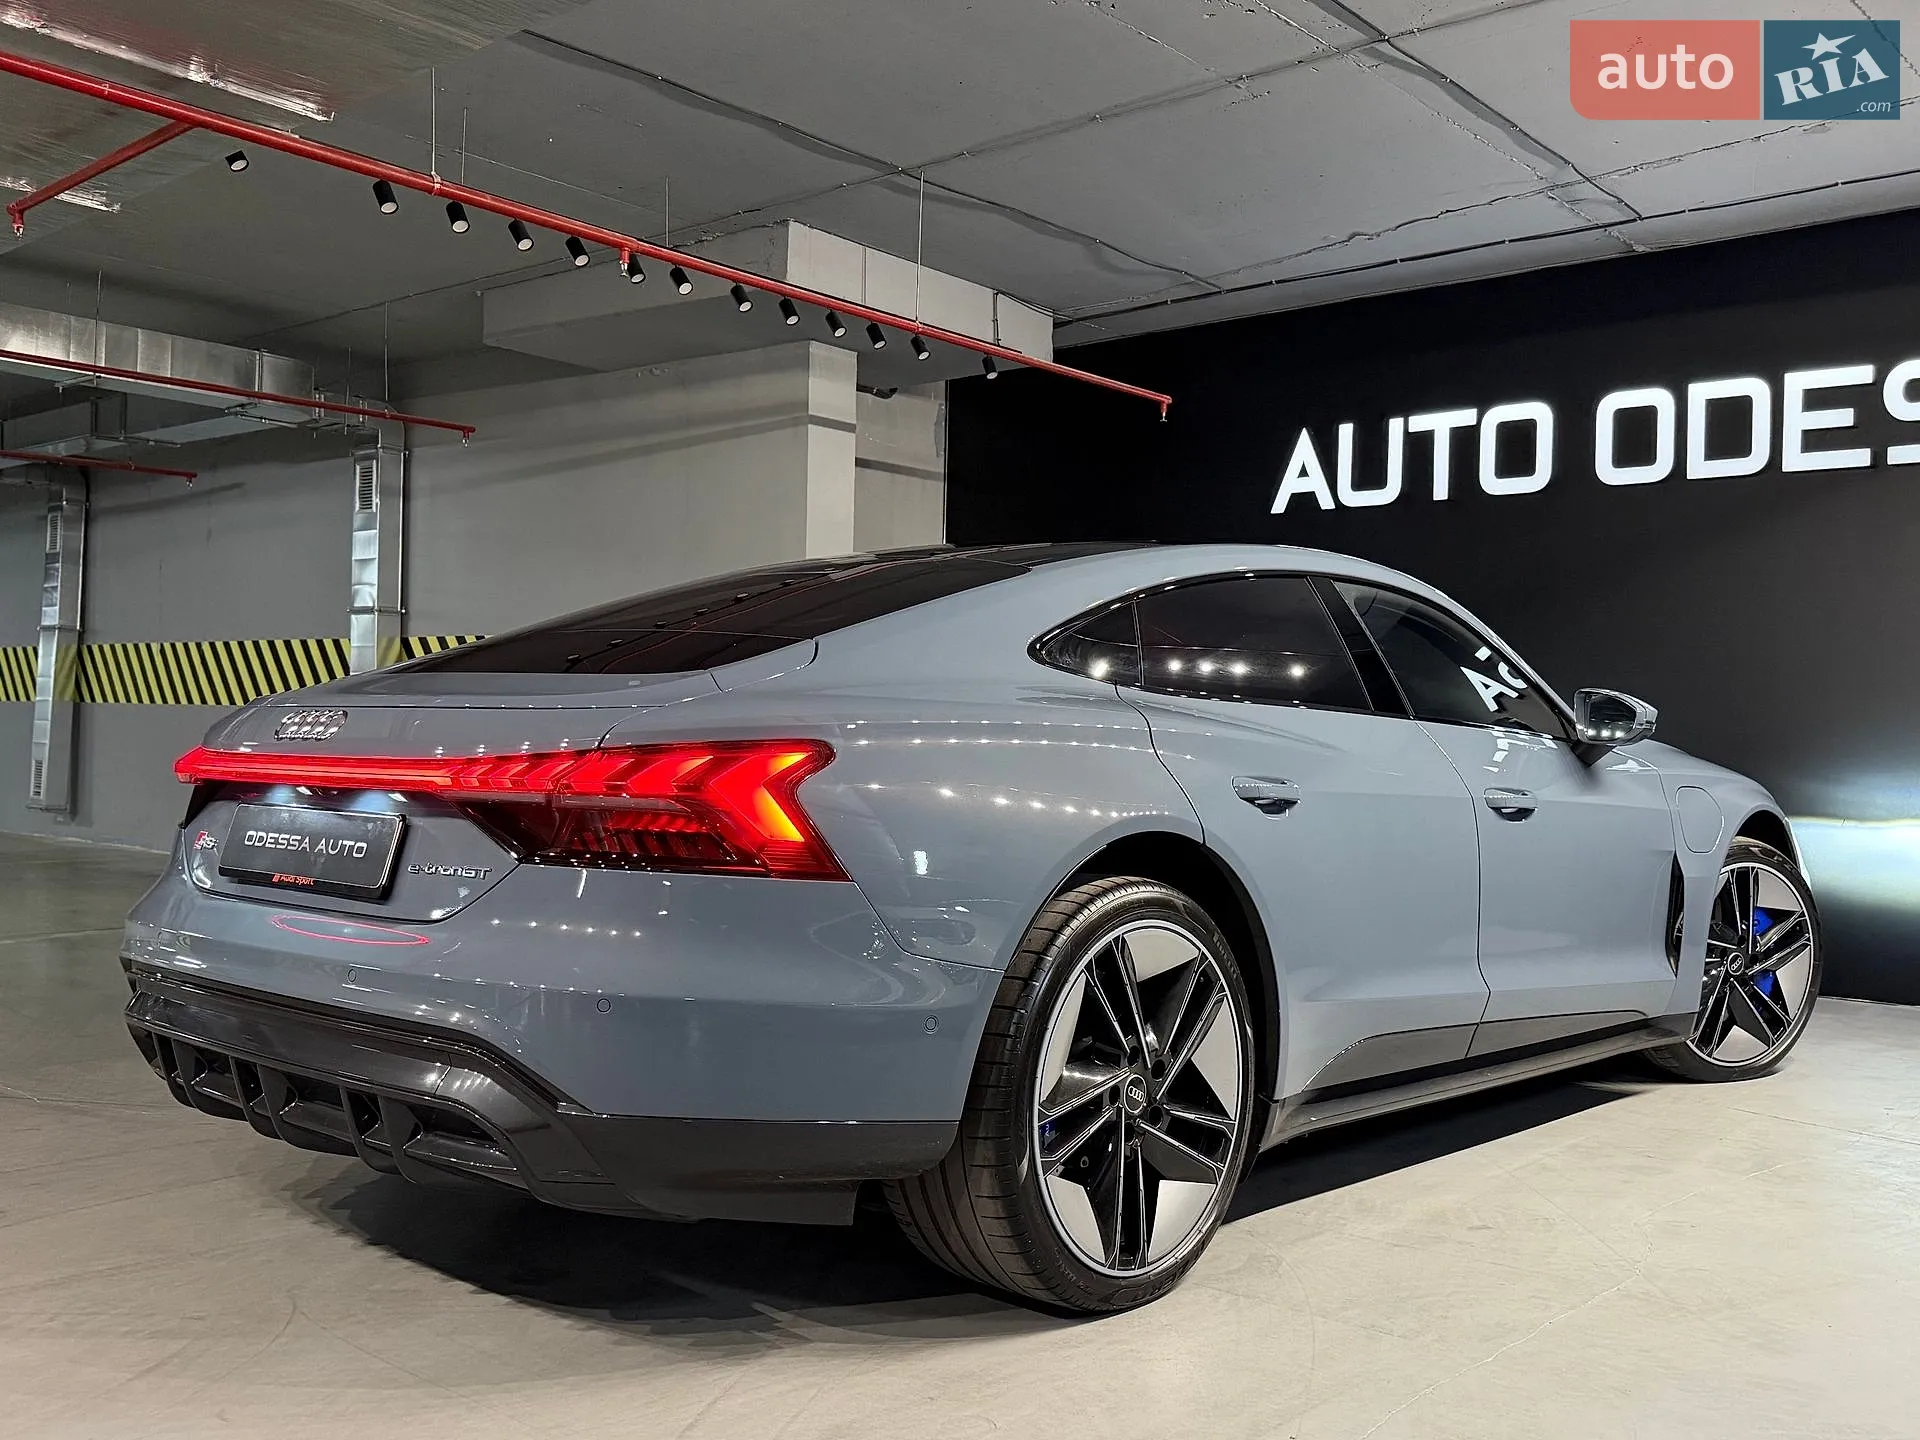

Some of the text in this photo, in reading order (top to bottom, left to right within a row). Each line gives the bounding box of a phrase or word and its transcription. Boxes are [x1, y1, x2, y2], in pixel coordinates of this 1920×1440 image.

[1270, 401, 1554, 514] AUTO
[244, 830, 368, 858] ODESSA AUTO
